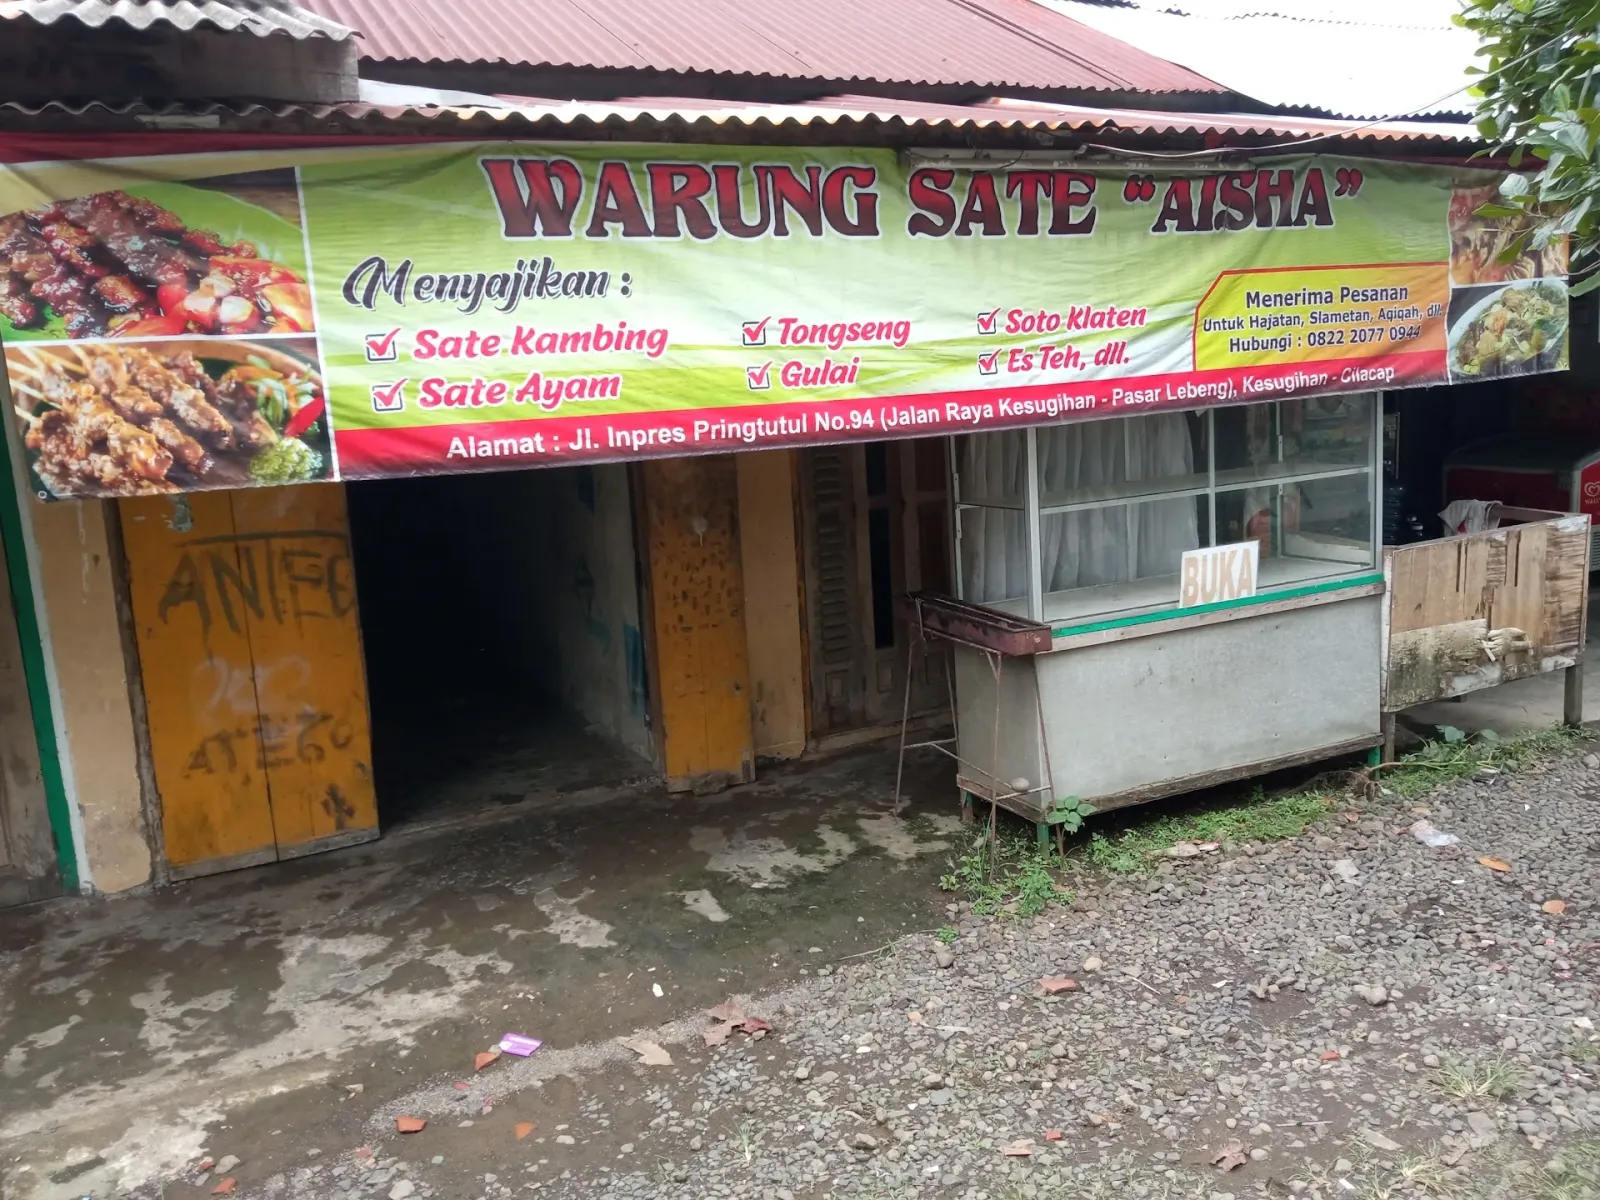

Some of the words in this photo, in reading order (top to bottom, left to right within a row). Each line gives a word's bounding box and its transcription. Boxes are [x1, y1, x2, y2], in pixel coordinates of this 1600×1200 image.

[480, 158, 880, 239] WARUNG
[907, 168, 1097, 237] SATE
[342, 256, 611, 315] Menyajikan
[1245, 287, 1334, 309] Menerima
[1339, 285, 1409, 304] Pesanan
[777, 317, 911, 350] Tongseng
[1004, 308, 1061, 335] Soto
[1065, 305, 1147, 331] Klaten
[1202, 315, 1245, 332] Untuk
[1249, 313, 1305, 331] Hajatan,
[1308, 308, 1374, 326] Slametan,
[1377, 305, 1423, 322] Aqiqah,
[1426, 303, 1443, 318] dll.
[413, 328, 501, 360] Sate
[510, 321, 669, 358] Kambing
[1229, 334, 1293, 353] Hubungi
[1307, 331, 1344, 347] 0822
[1349, 328, 1385, 343] 2077
[1388, 325, 1421, 341] 0944
[780, 357, 860, 387] Gulai
[1006, 348, 1033, 373] Es
[1034, 344, 1087, 372] Teh,
[1093, 341, 1130, 367] dll.
[419, 377, 509, 410] Sate
[515, 371, 621, 410] Ayam
[446, 432, 545, 459] Alamat
[568, 428, 600, 451] Jl.
[607, 424, 686, 451] Inpres
[693, 412, 807, 442] Pringtutul
[814, 407, 875, 432] No.94
[880, 404, 941, 432] (Jalan
[945, 401, 995, 424] Raya
[998, 391, 1097, 417] Kesugihan
[1111, 386, 1162, 407] Pasar
[1165, 377, 1238, 402] Lebeng),
[1241, 370, 1328, 395] Kesugihan
[1340, 365, 1396, 385] Cilacap
[1181, 547, 1254, 607] BUKA
